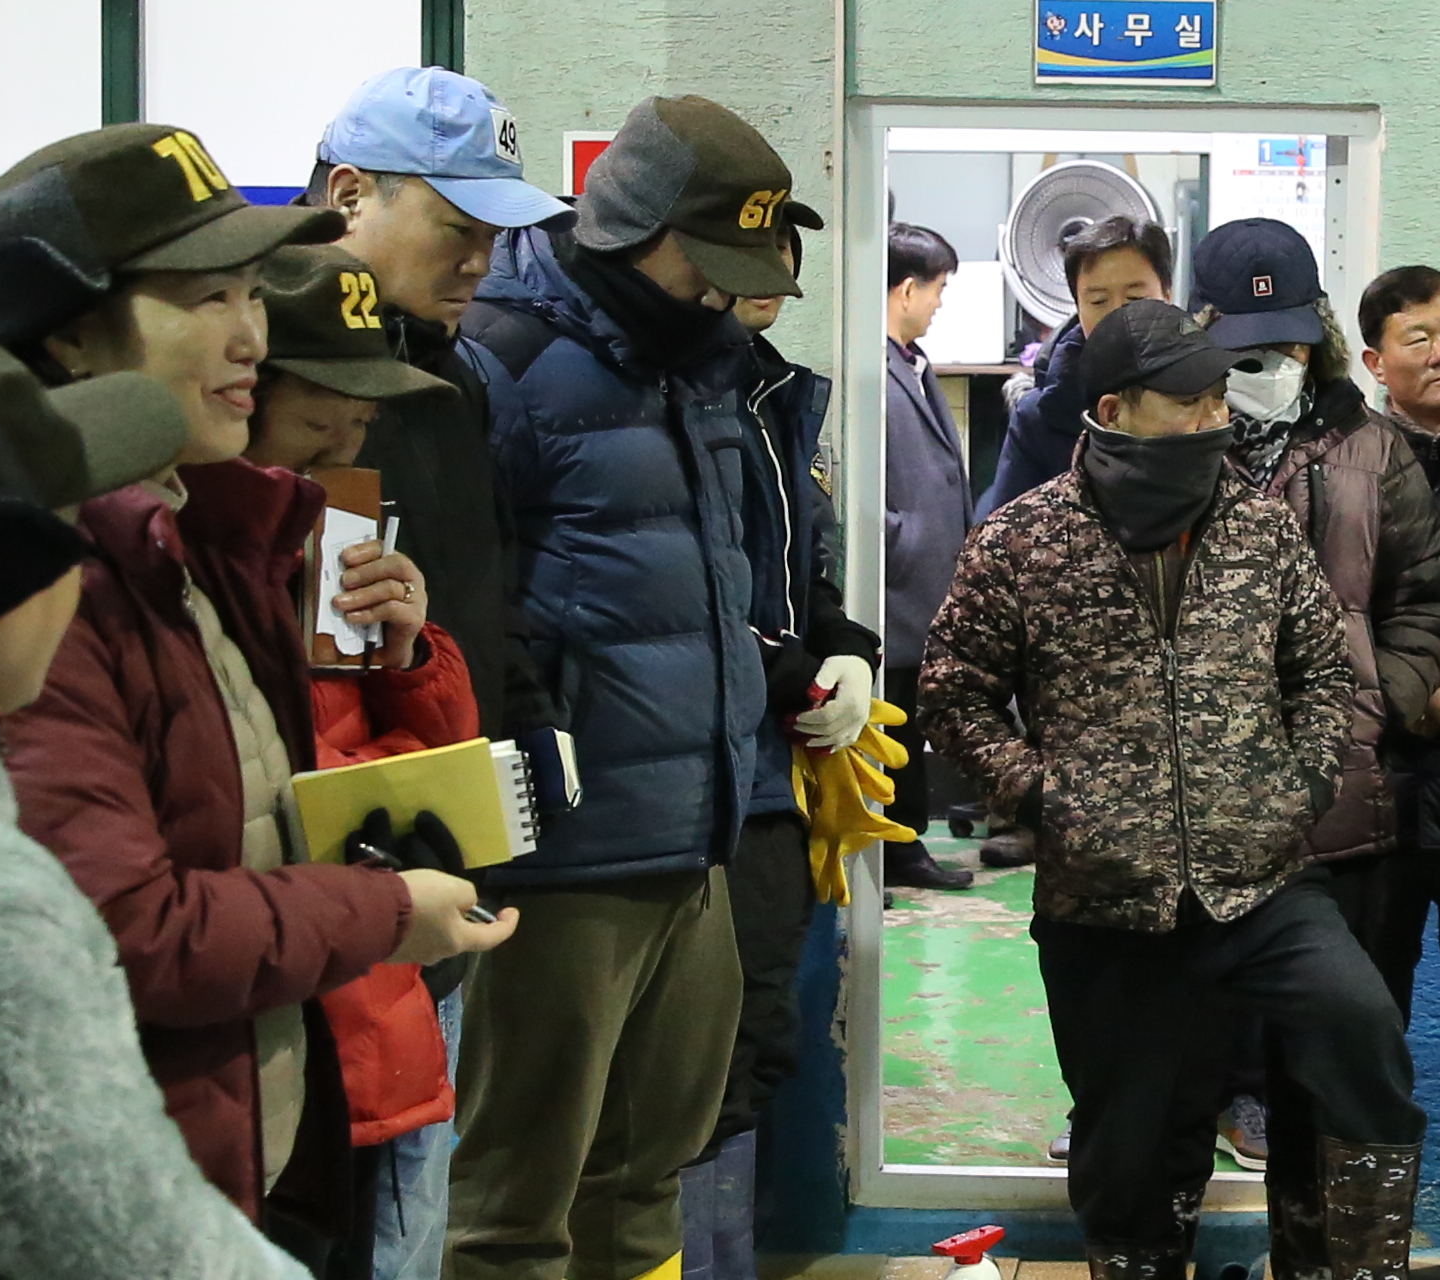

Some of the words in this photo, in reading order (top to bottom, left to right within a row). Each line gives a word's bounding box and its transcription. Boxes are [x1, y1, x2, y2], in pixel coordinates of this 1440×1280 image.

[498, 119, 517, 155] 49
[151, 130, 229, 202] 70
[738, 188, 788, 229] 61
[338, 271, 383, 329] 22
